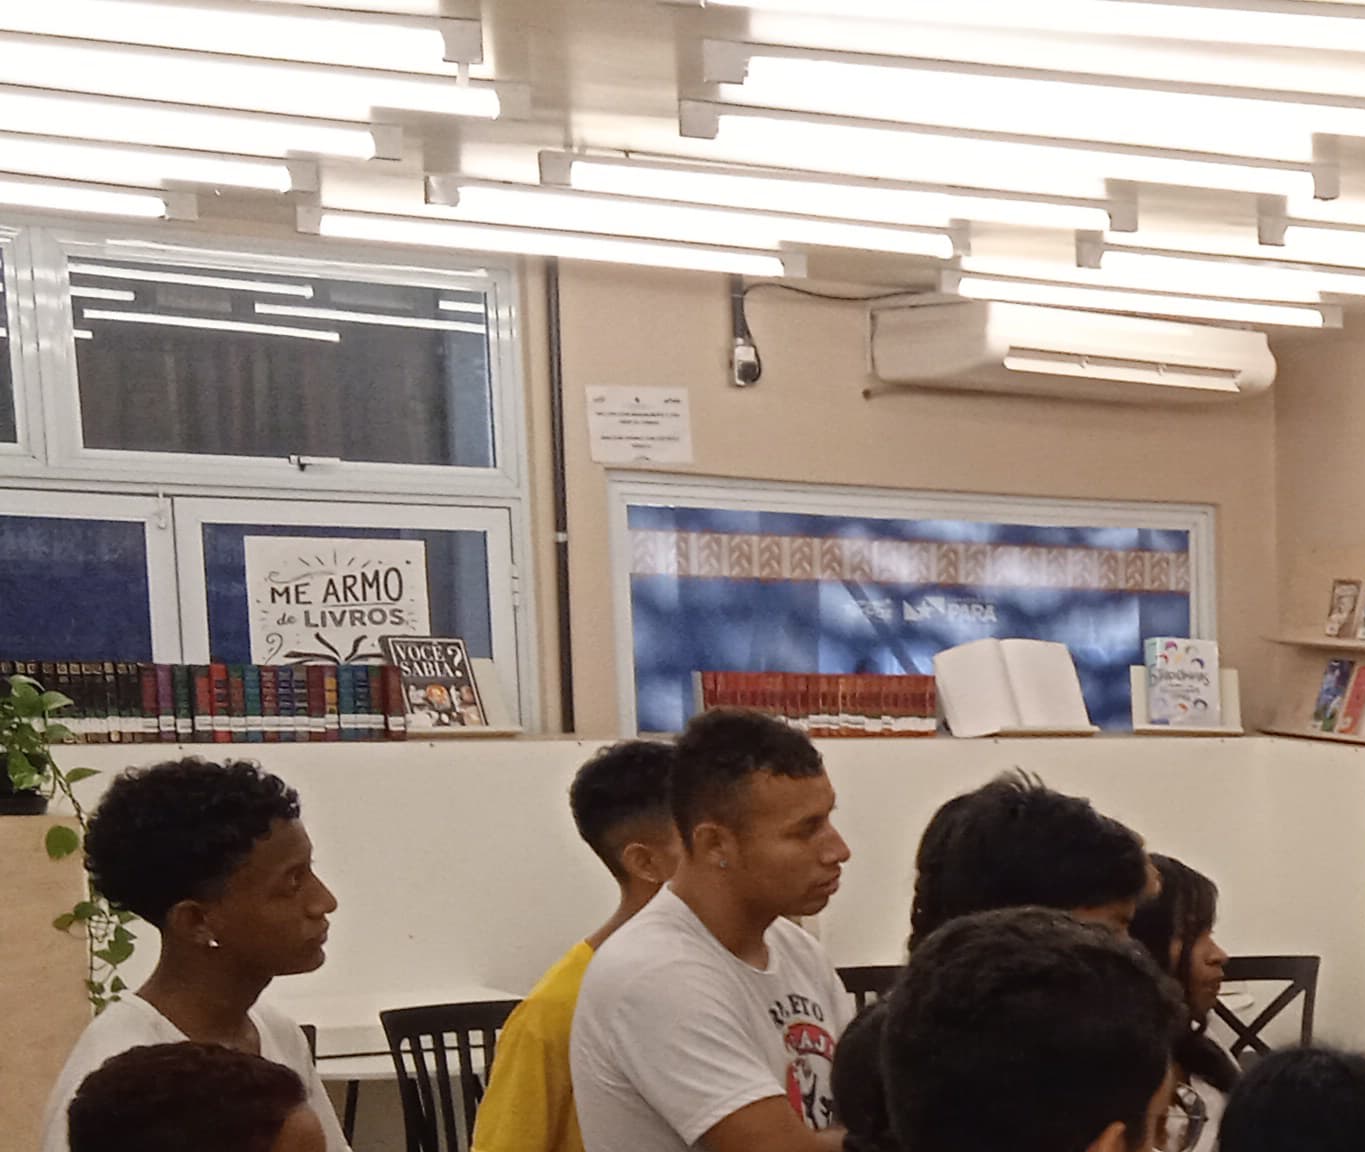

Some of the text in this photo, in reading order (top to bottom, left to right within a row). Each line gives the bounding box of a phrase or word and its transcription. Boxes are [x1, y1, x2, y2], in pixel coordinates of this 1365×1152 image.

[270, 567, 403, 605] ME ARMO
[276, 608, 405, 628] de LIVROS
